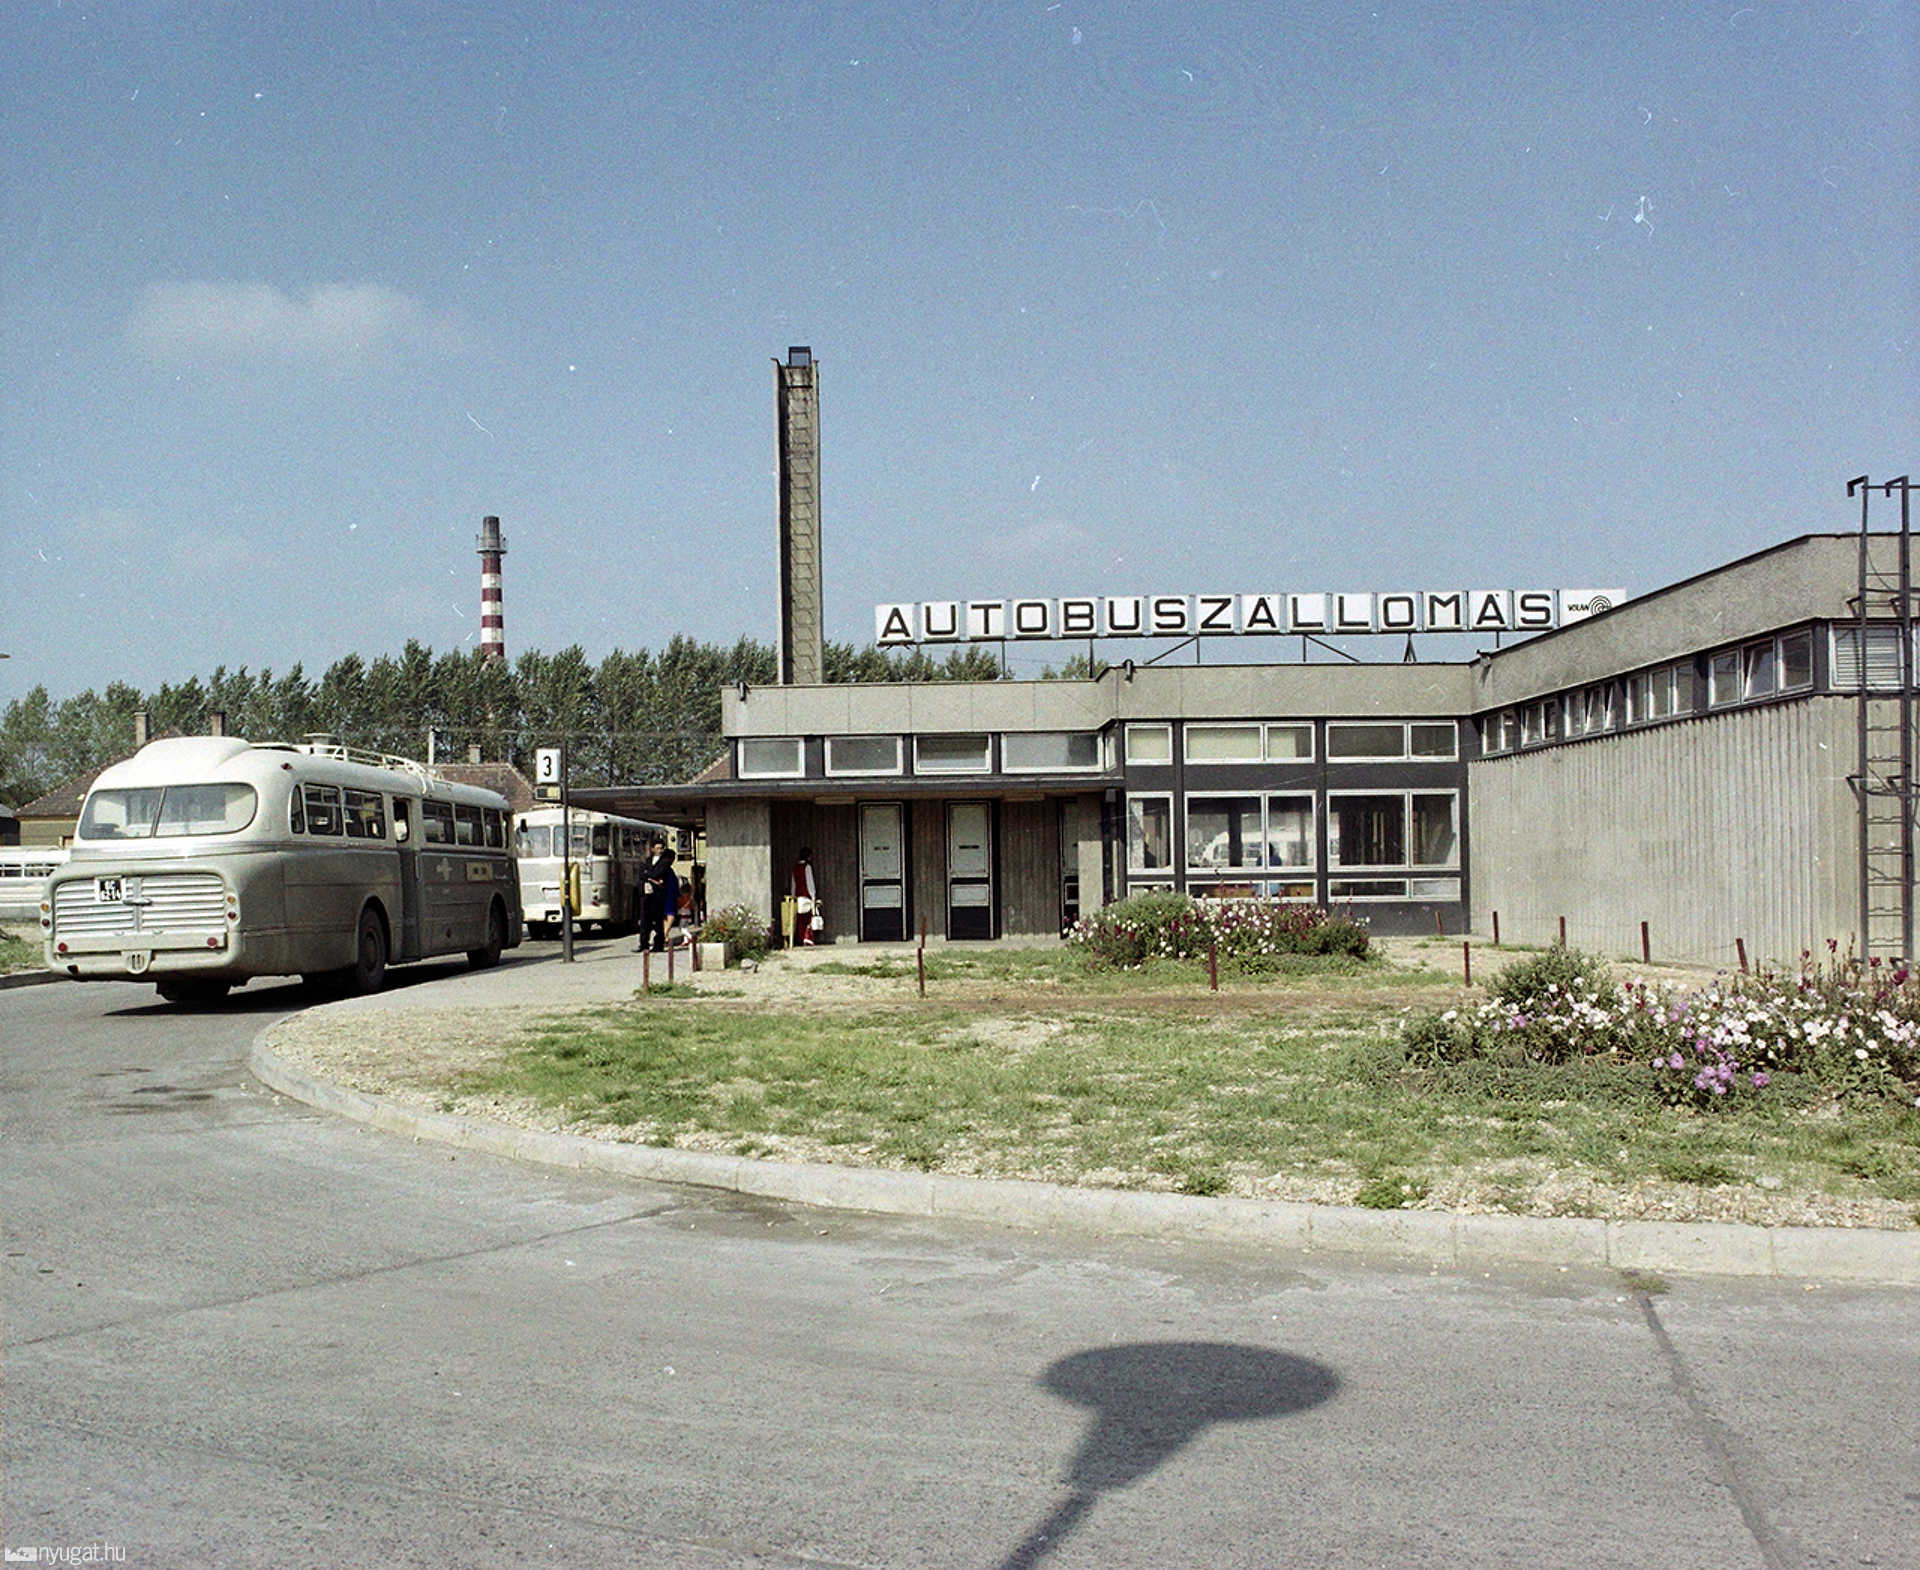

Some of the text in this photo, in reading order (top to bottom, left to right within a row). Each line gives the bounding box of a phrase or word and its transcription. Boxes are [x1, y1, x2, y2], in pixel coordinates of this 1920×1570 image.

[881, 593, 1552, 638] AUTOBUSZÁLLOMÁS
[543, 755, 552, 777] 3
[680, 834, 688, 848] 2
